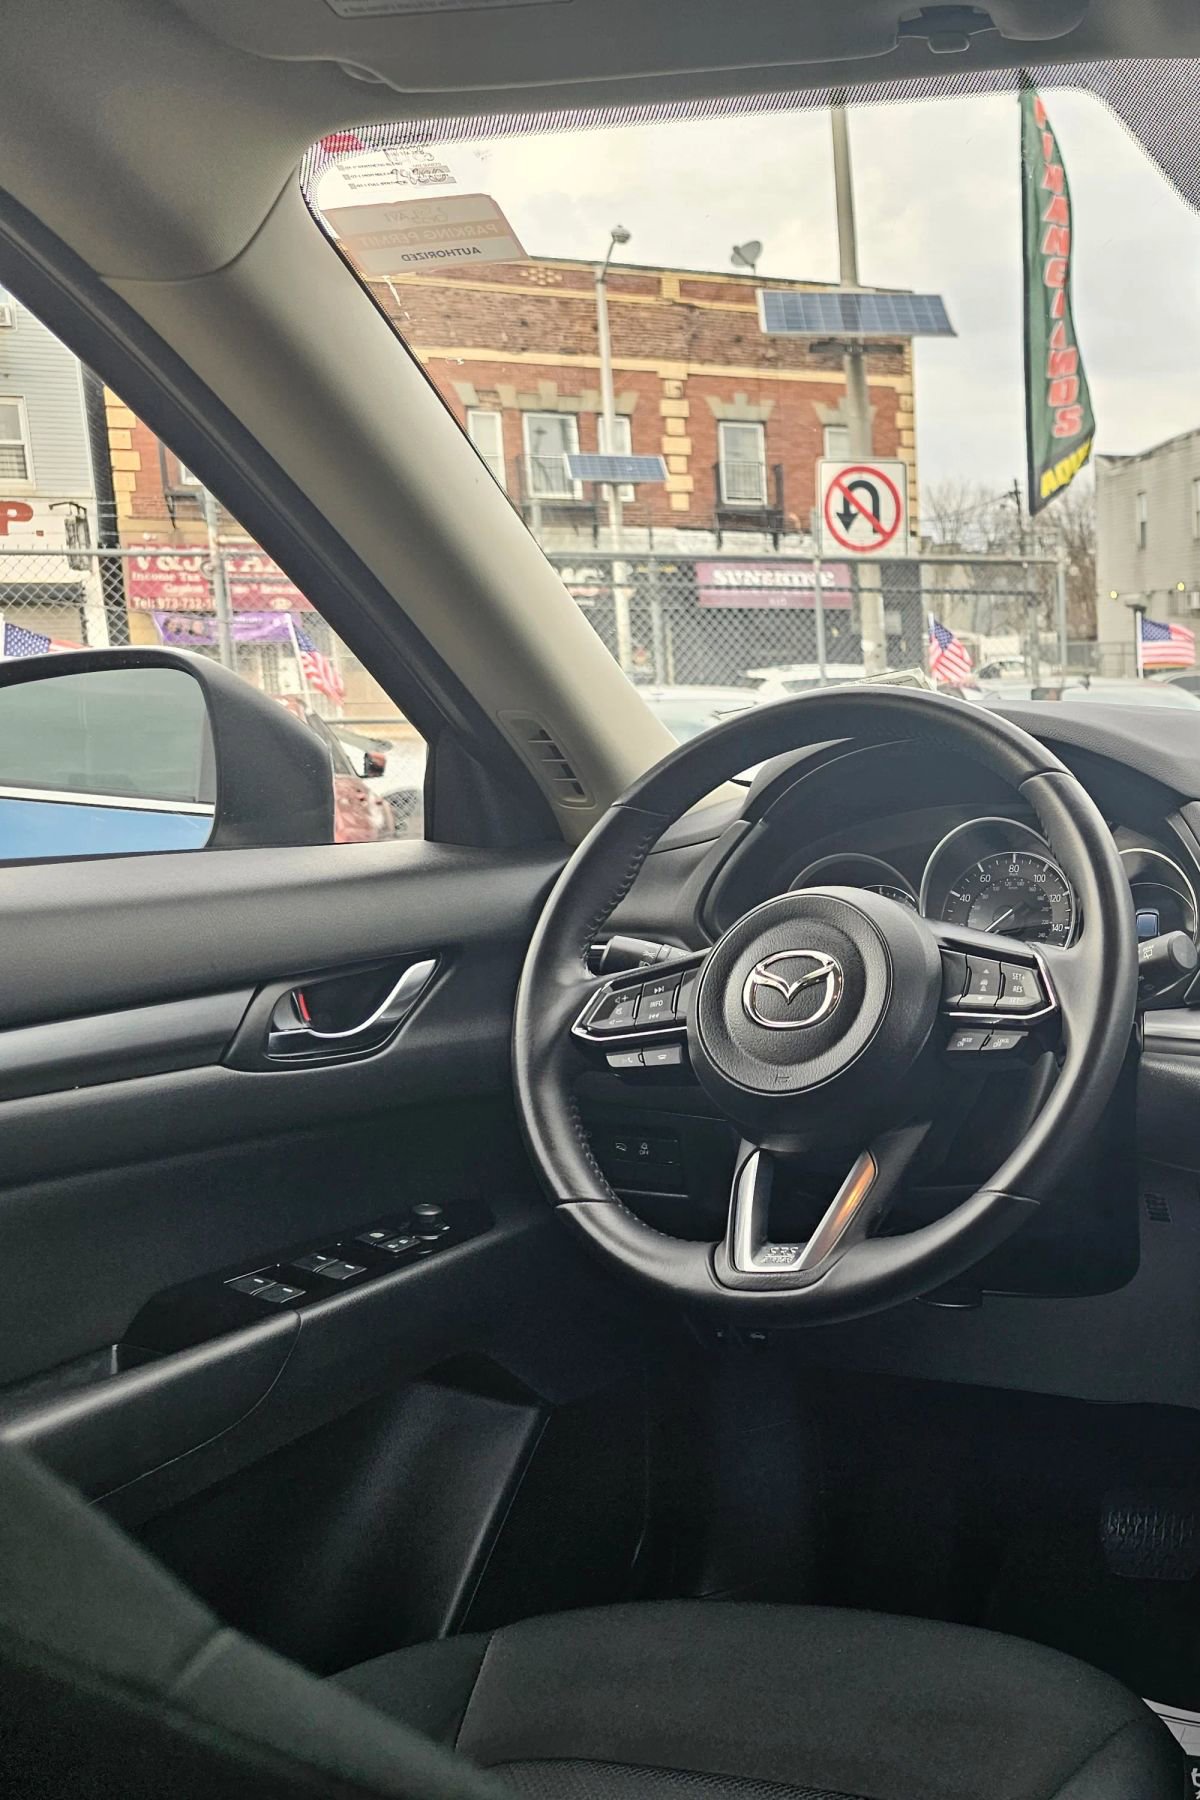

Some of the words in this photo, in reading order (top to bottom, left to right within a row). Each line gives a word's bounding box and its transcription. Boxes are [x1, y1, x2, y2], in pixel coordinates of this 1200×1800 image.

[1008, 864, 1020, 873] 80
[980, 874, 991, 883] 60
[1033, 874, 1046, 883] 100
[959, 894, 971, 903] 40
[1049, 894, 1061, 903] 120
[1051, 923, 1064, 932] 140
[1012, 985, 1023, 993] RES
[649, 1000, 664, 1008] INFO
